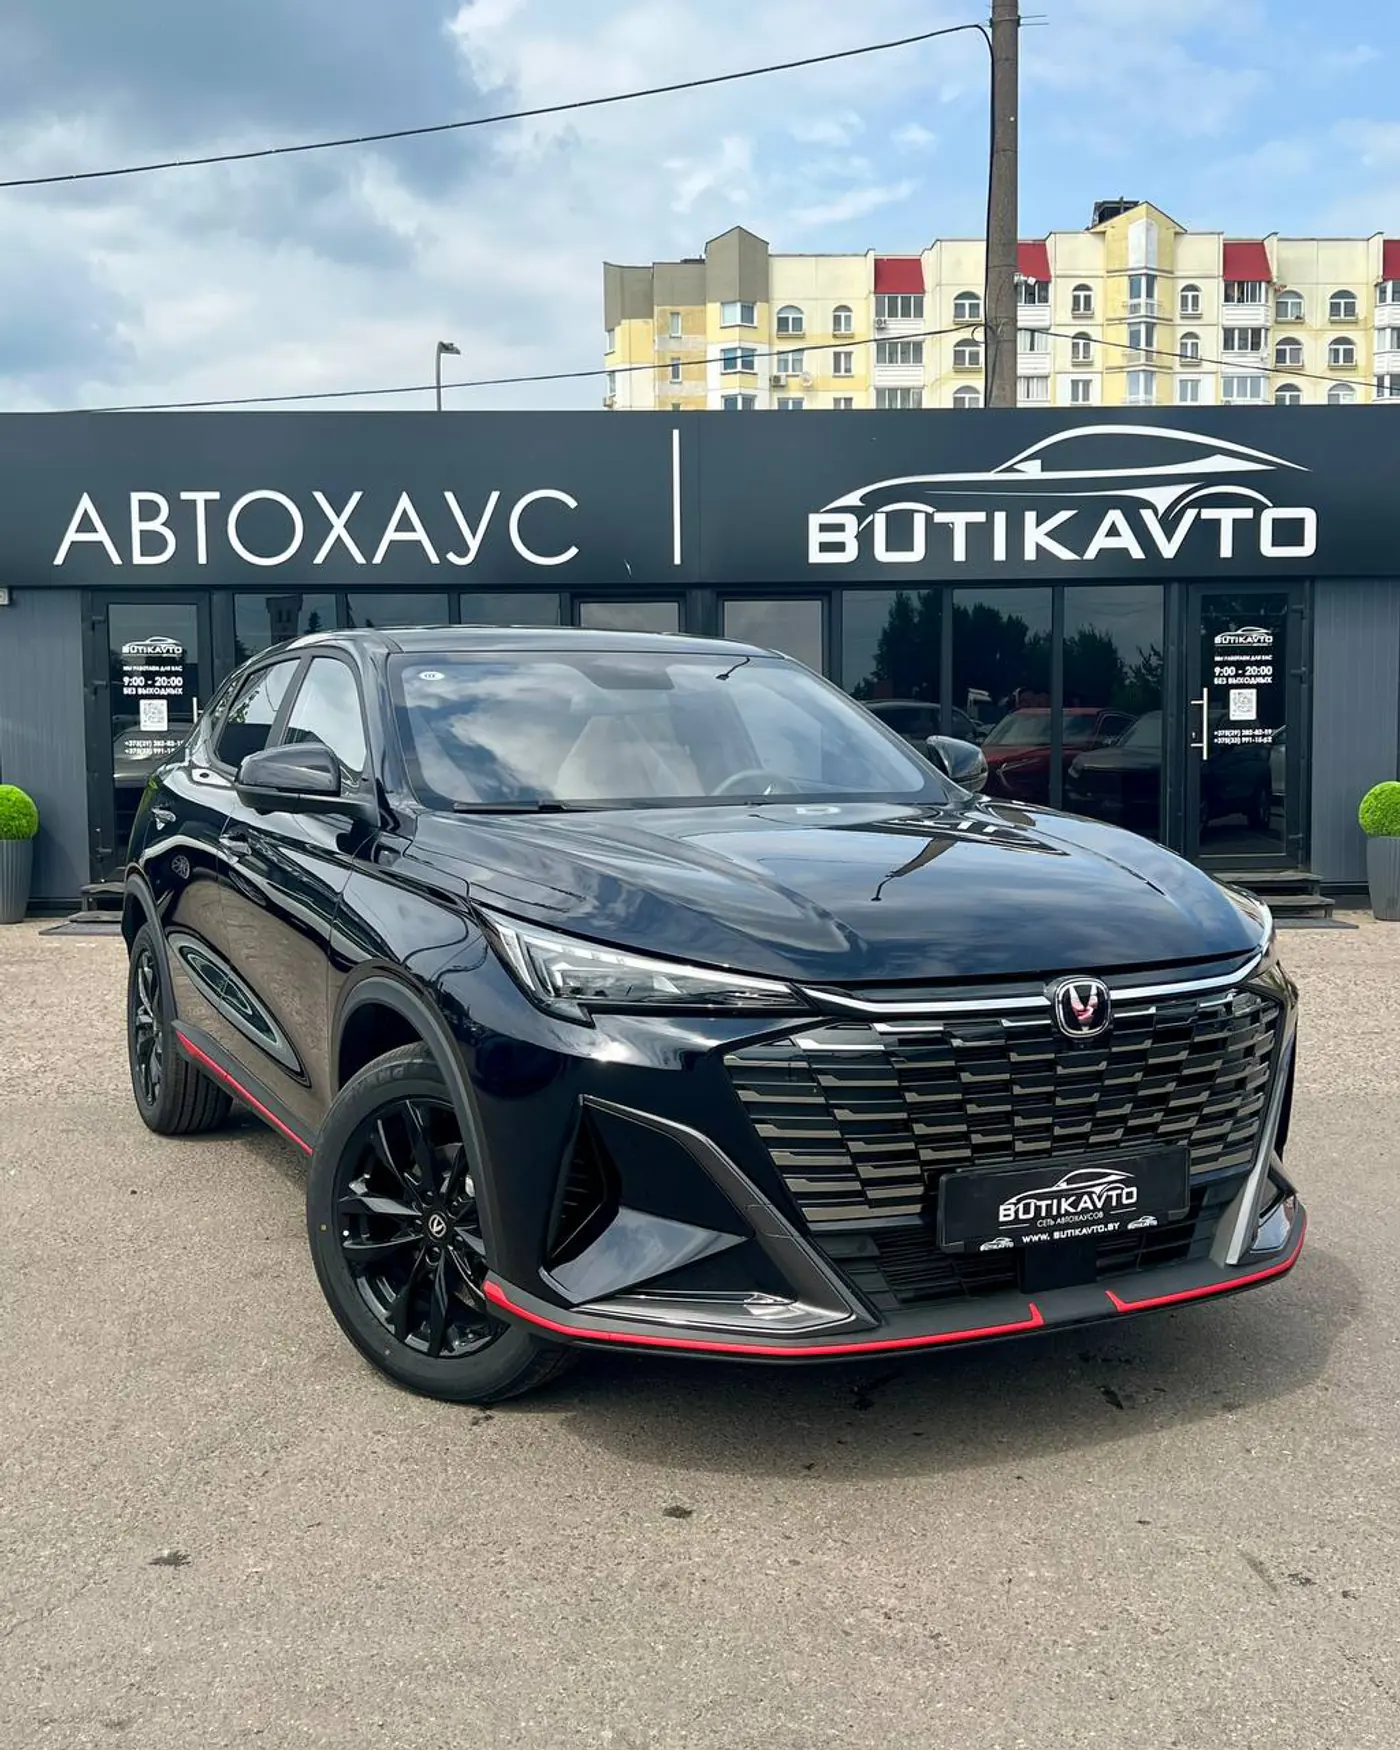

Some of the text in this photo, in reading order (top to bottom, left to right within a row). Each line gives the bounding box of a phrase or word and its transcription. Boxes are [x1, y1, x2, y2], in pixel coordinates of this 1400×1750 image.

[53, 489, 579, 567] АВТОХАУС
[808, 507, 1317, 563] BUTIKAVTO
[1214, 635, 1273, 644] BUTIKAVTO
[122, 645, 183, 654] BUTIKAVTO
[1214, 665, 1236, 676] 9:00
[1245, 665, 1273, 676] 20:00
[123, 676, 145, 686] 9:00
[154, 676, 183, 687] 20:00
[1214, 676, 1273, 685] БЕЗ ВЫХОДНЫХ
[123, 687, 183, 695] БЕЗ ВЫХОДНЫХ
[998, 1187, 1138, 1222] BUTIKAVTO
[1022, 1222, 1120, 1244] WWW. BUTIKAVTO.BY
